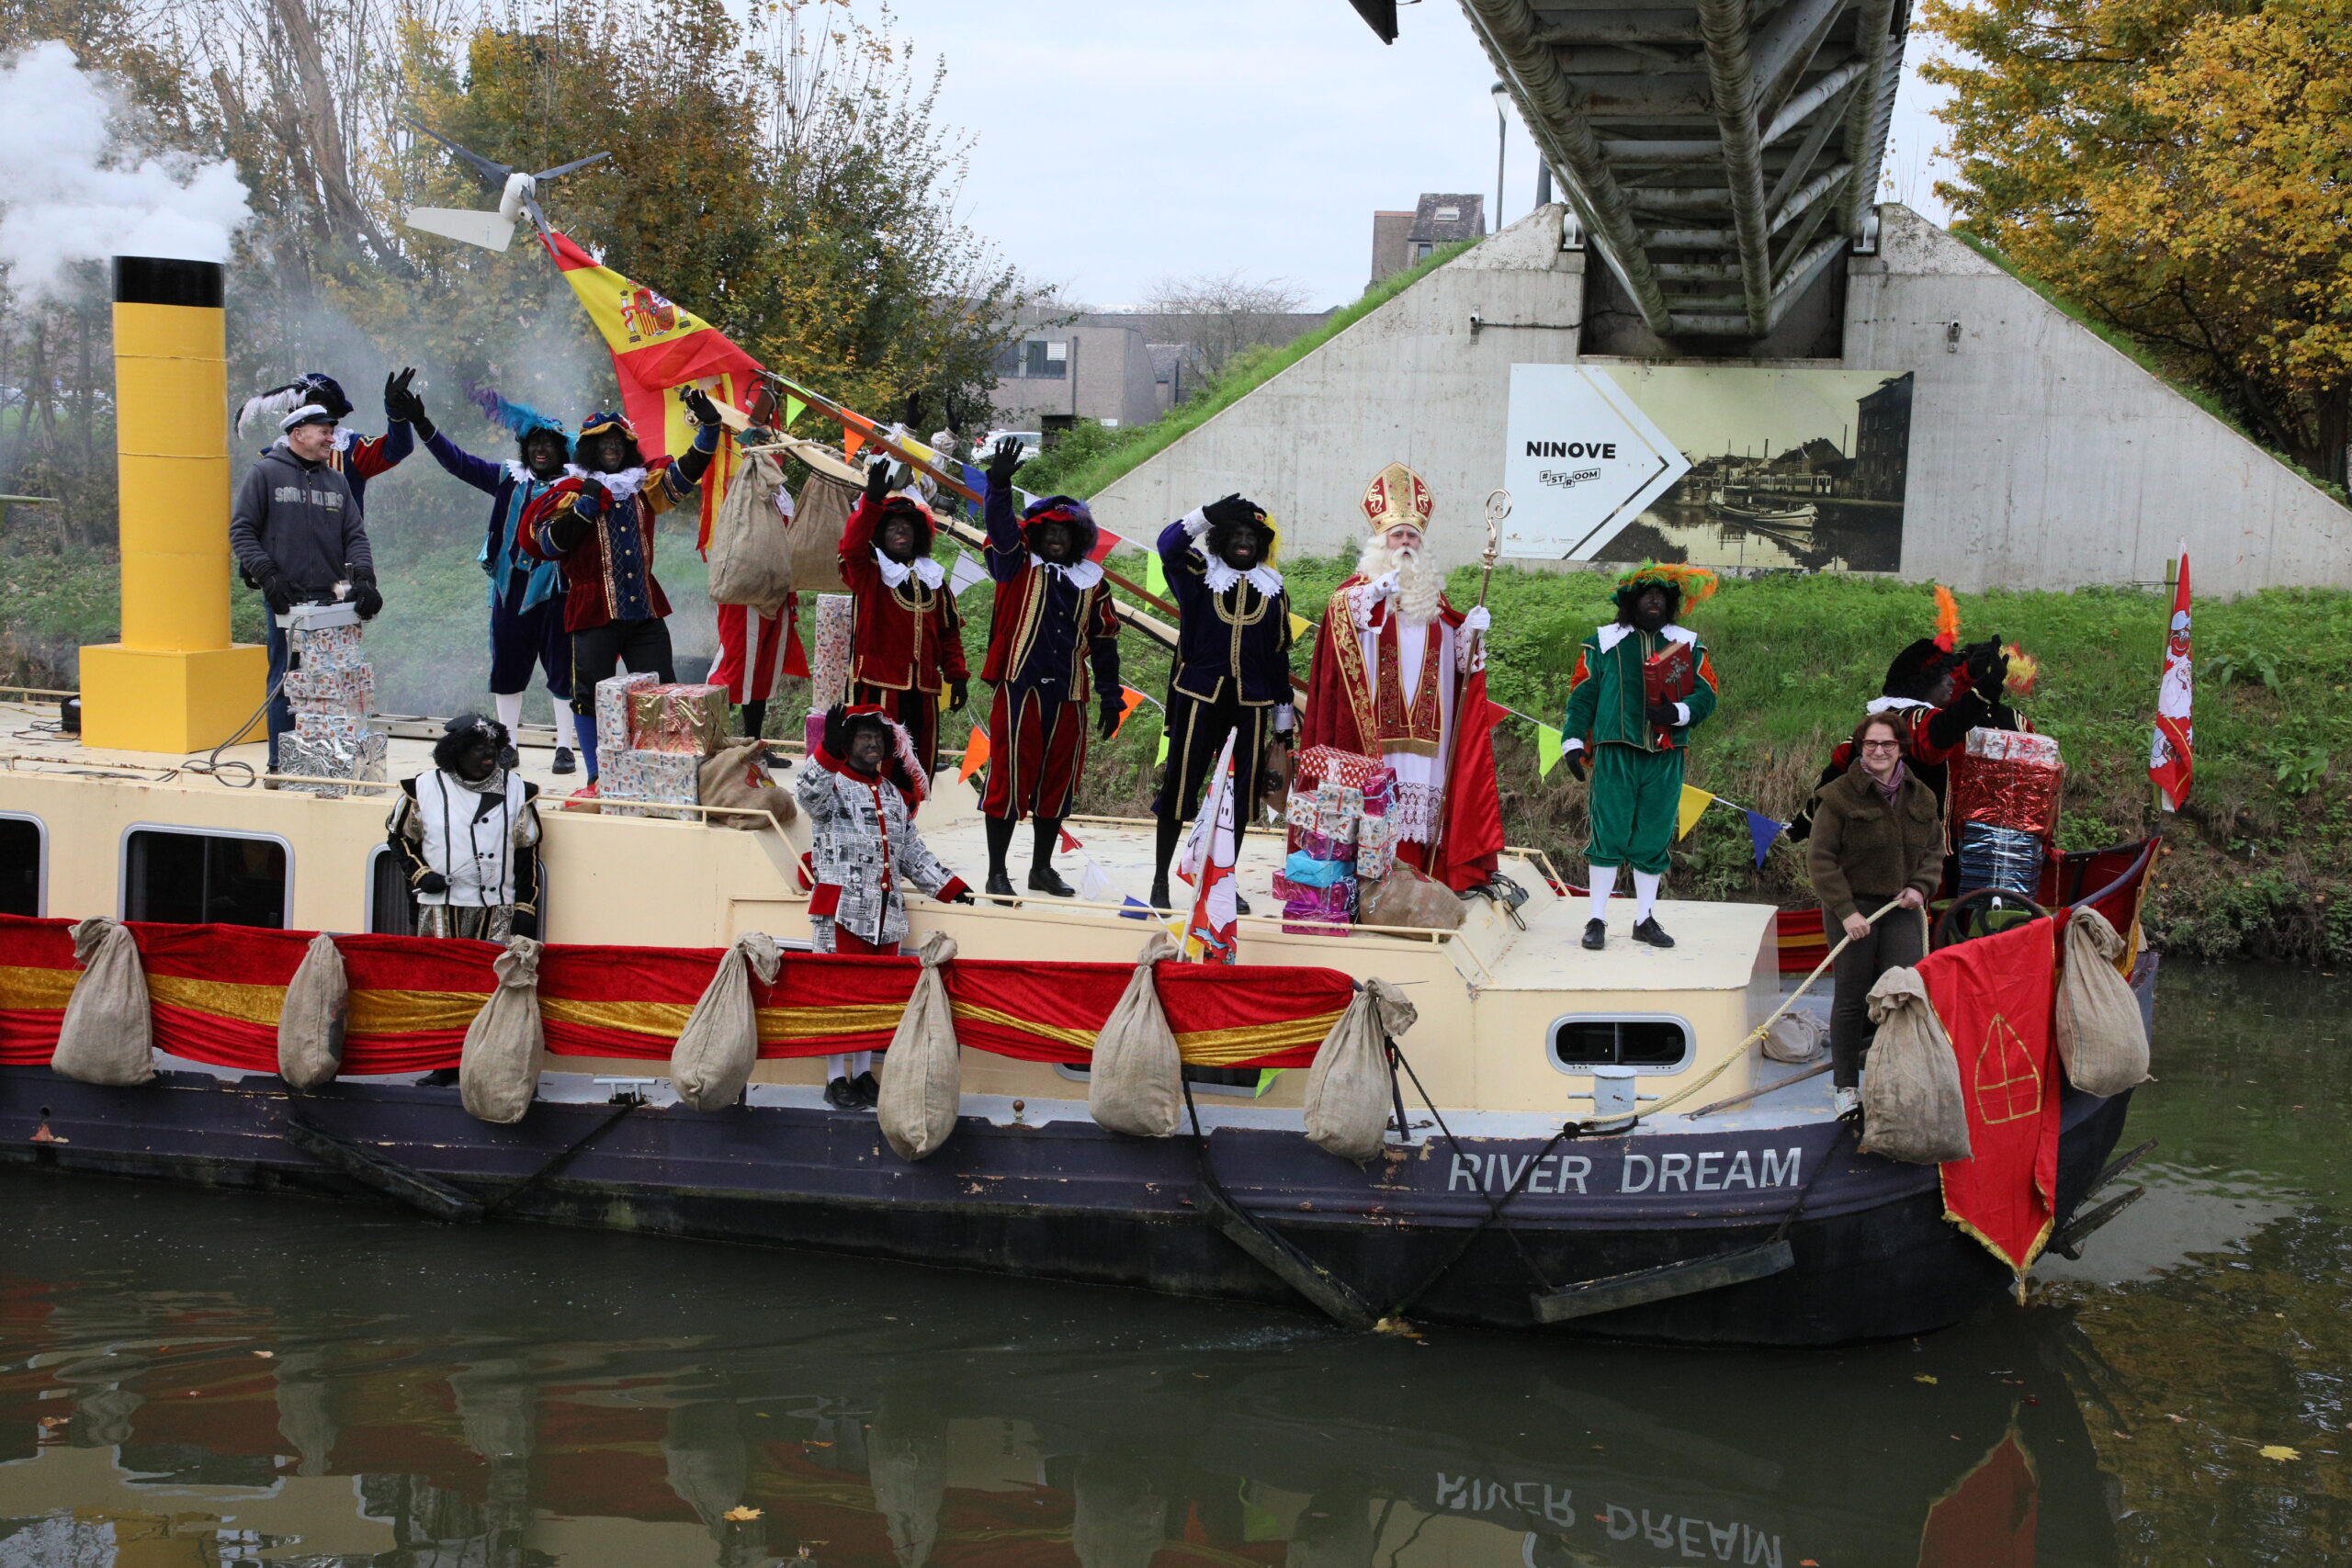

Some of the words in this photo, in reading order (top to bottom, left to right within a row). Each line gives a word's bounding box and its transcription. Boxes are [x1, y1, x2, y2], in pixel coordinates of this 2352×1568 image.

[1526, 441, 1616, 458] NINOVE
[1541, 469, 1599, 487] #STROOM
[1448, 1153, 1592, 1194] RIVER
[1621, 1147, 1802, 1194] DREAM
